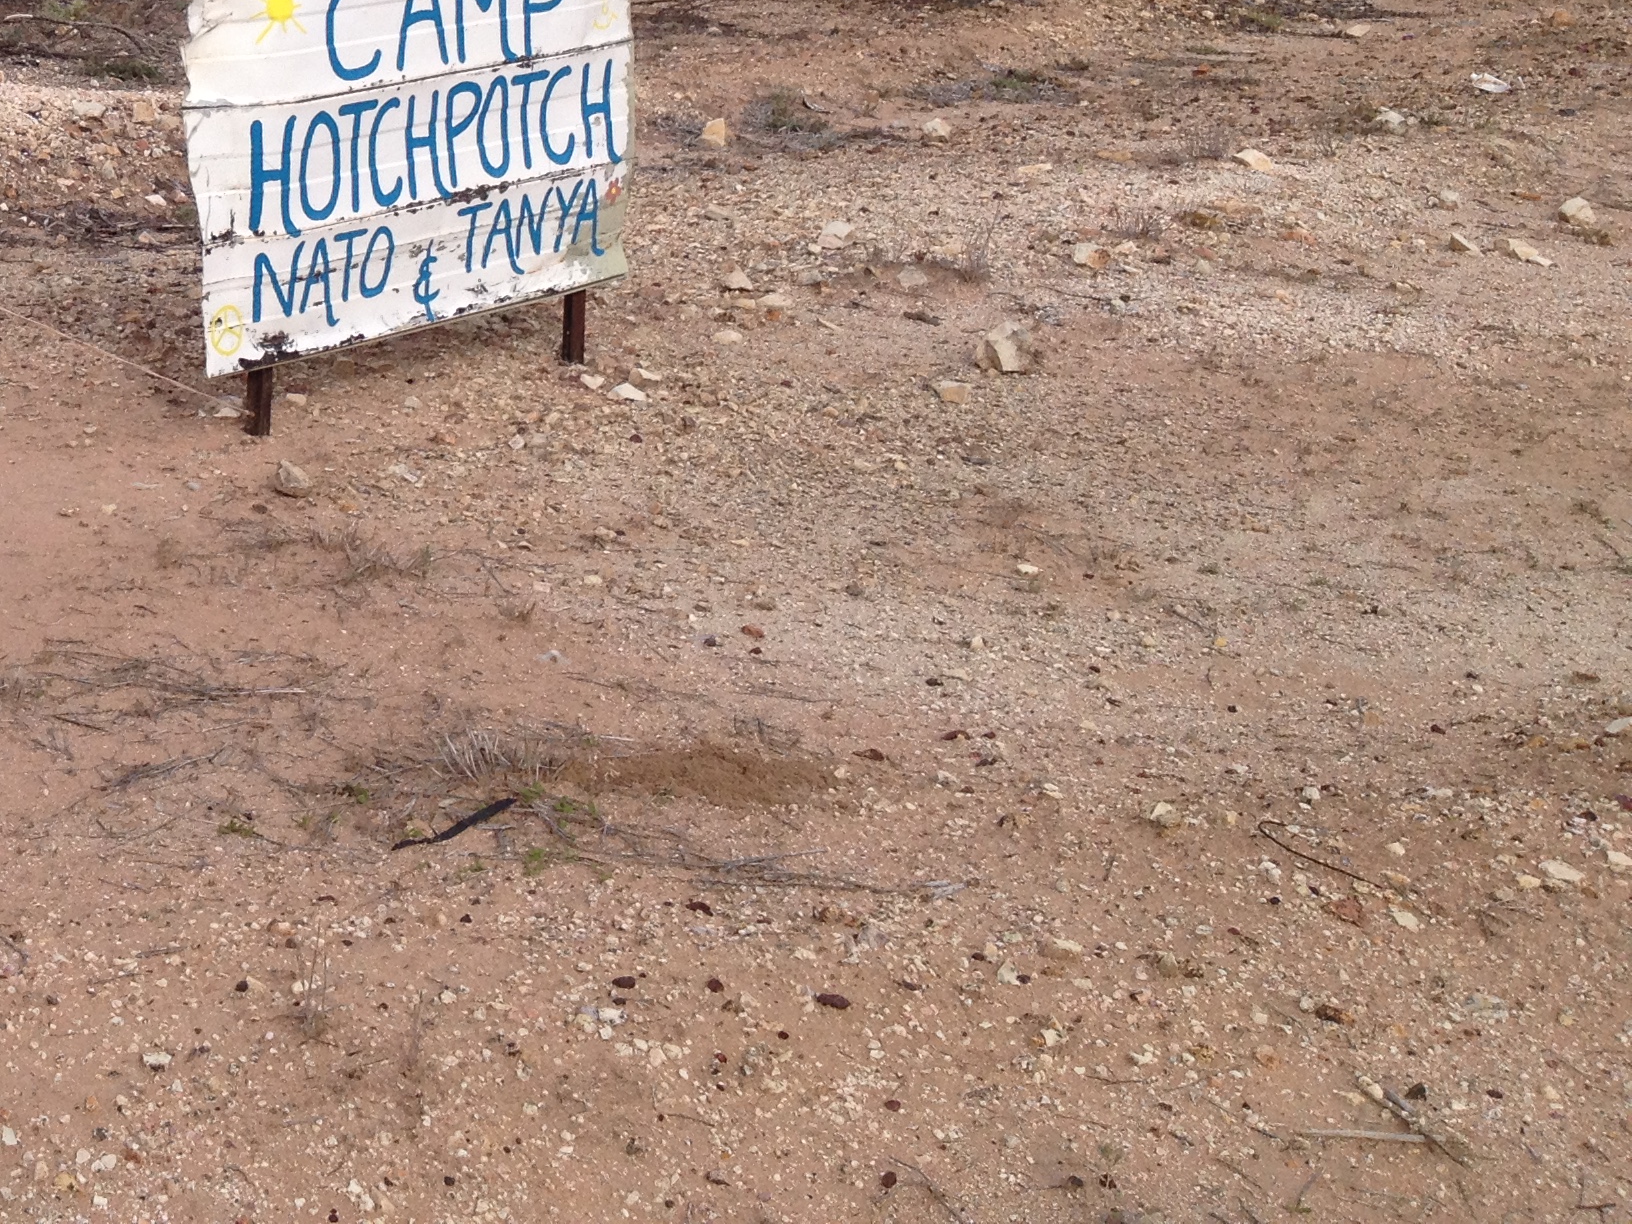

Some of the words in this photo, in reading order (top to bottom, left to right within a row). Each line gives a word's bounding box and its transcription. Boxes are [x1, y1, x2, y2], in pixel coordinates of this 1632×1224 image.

[249, 60, 623, 238] HOTCHPOTCH
[252, 225, 395, 328] NATO
[413, 240, 440, 323] &
[458, 178, 607, 276] TANYA
